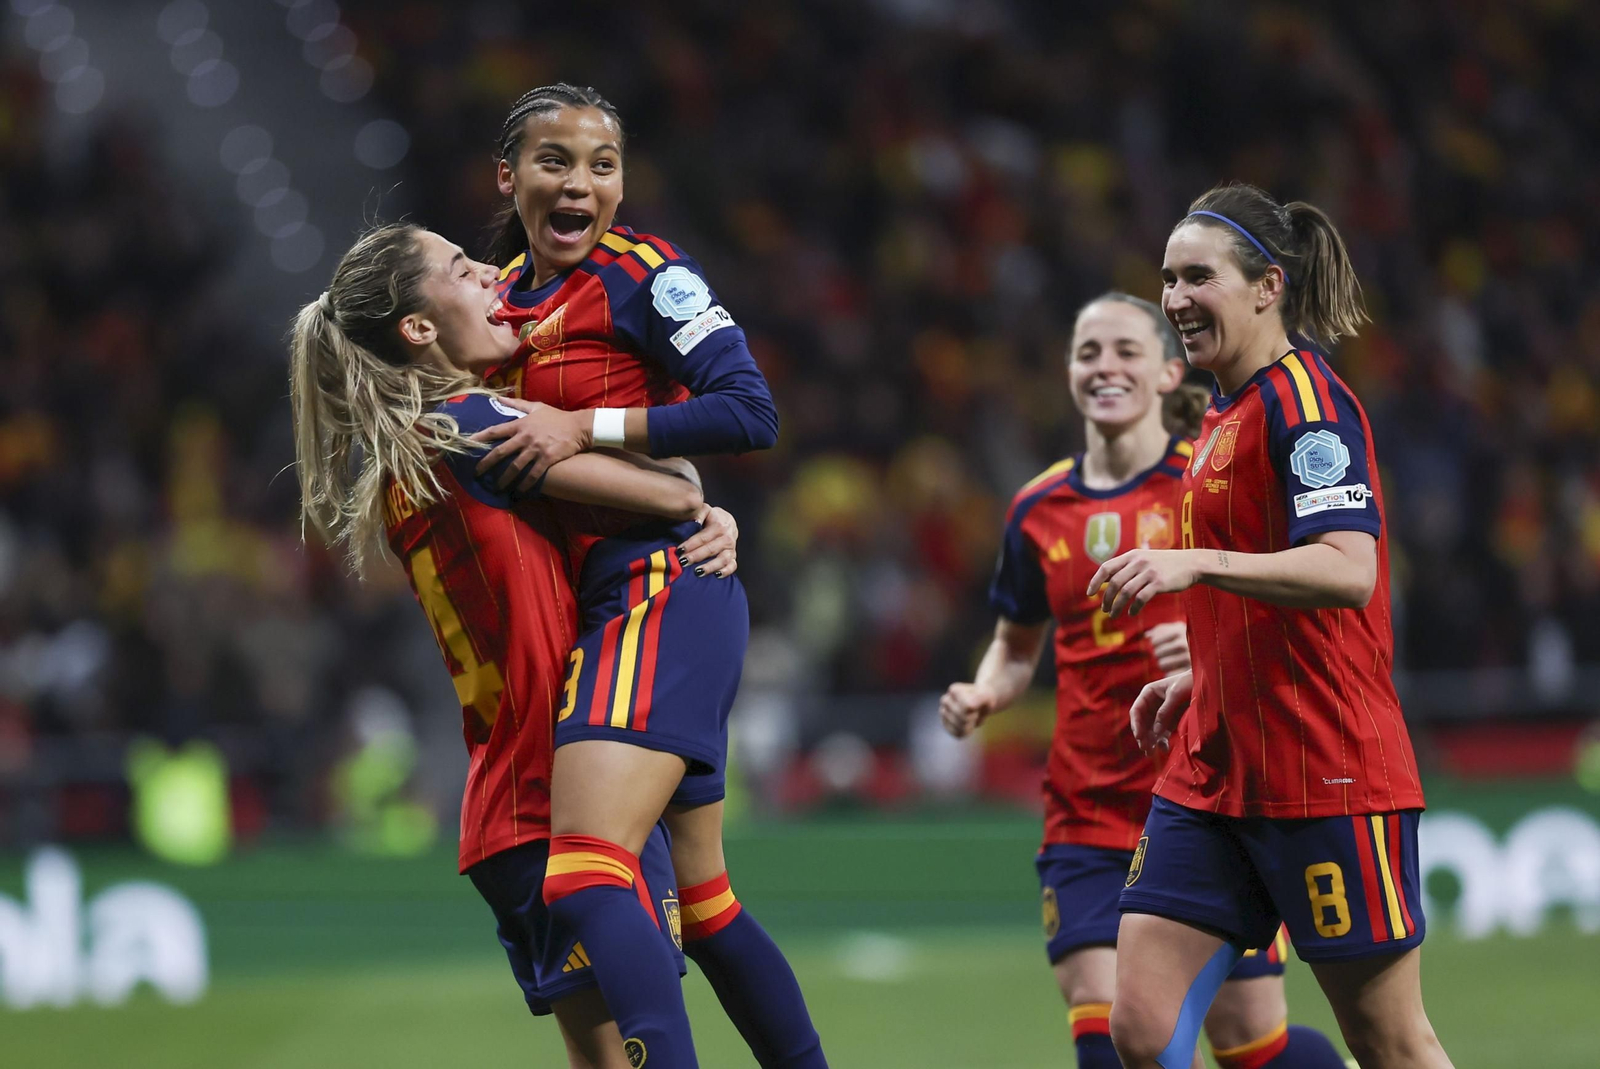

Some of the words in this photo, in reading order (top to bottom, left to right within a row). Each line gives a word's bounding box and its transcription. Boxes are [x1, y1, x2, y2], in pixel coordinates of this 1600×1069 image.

[676, 316, 718, 349] FOUNDATION
[1297, 494, 1345, 508] FOUNDATION
[411, 545, 504, 727] 4
[1306, 861, 1352, 938] 8
